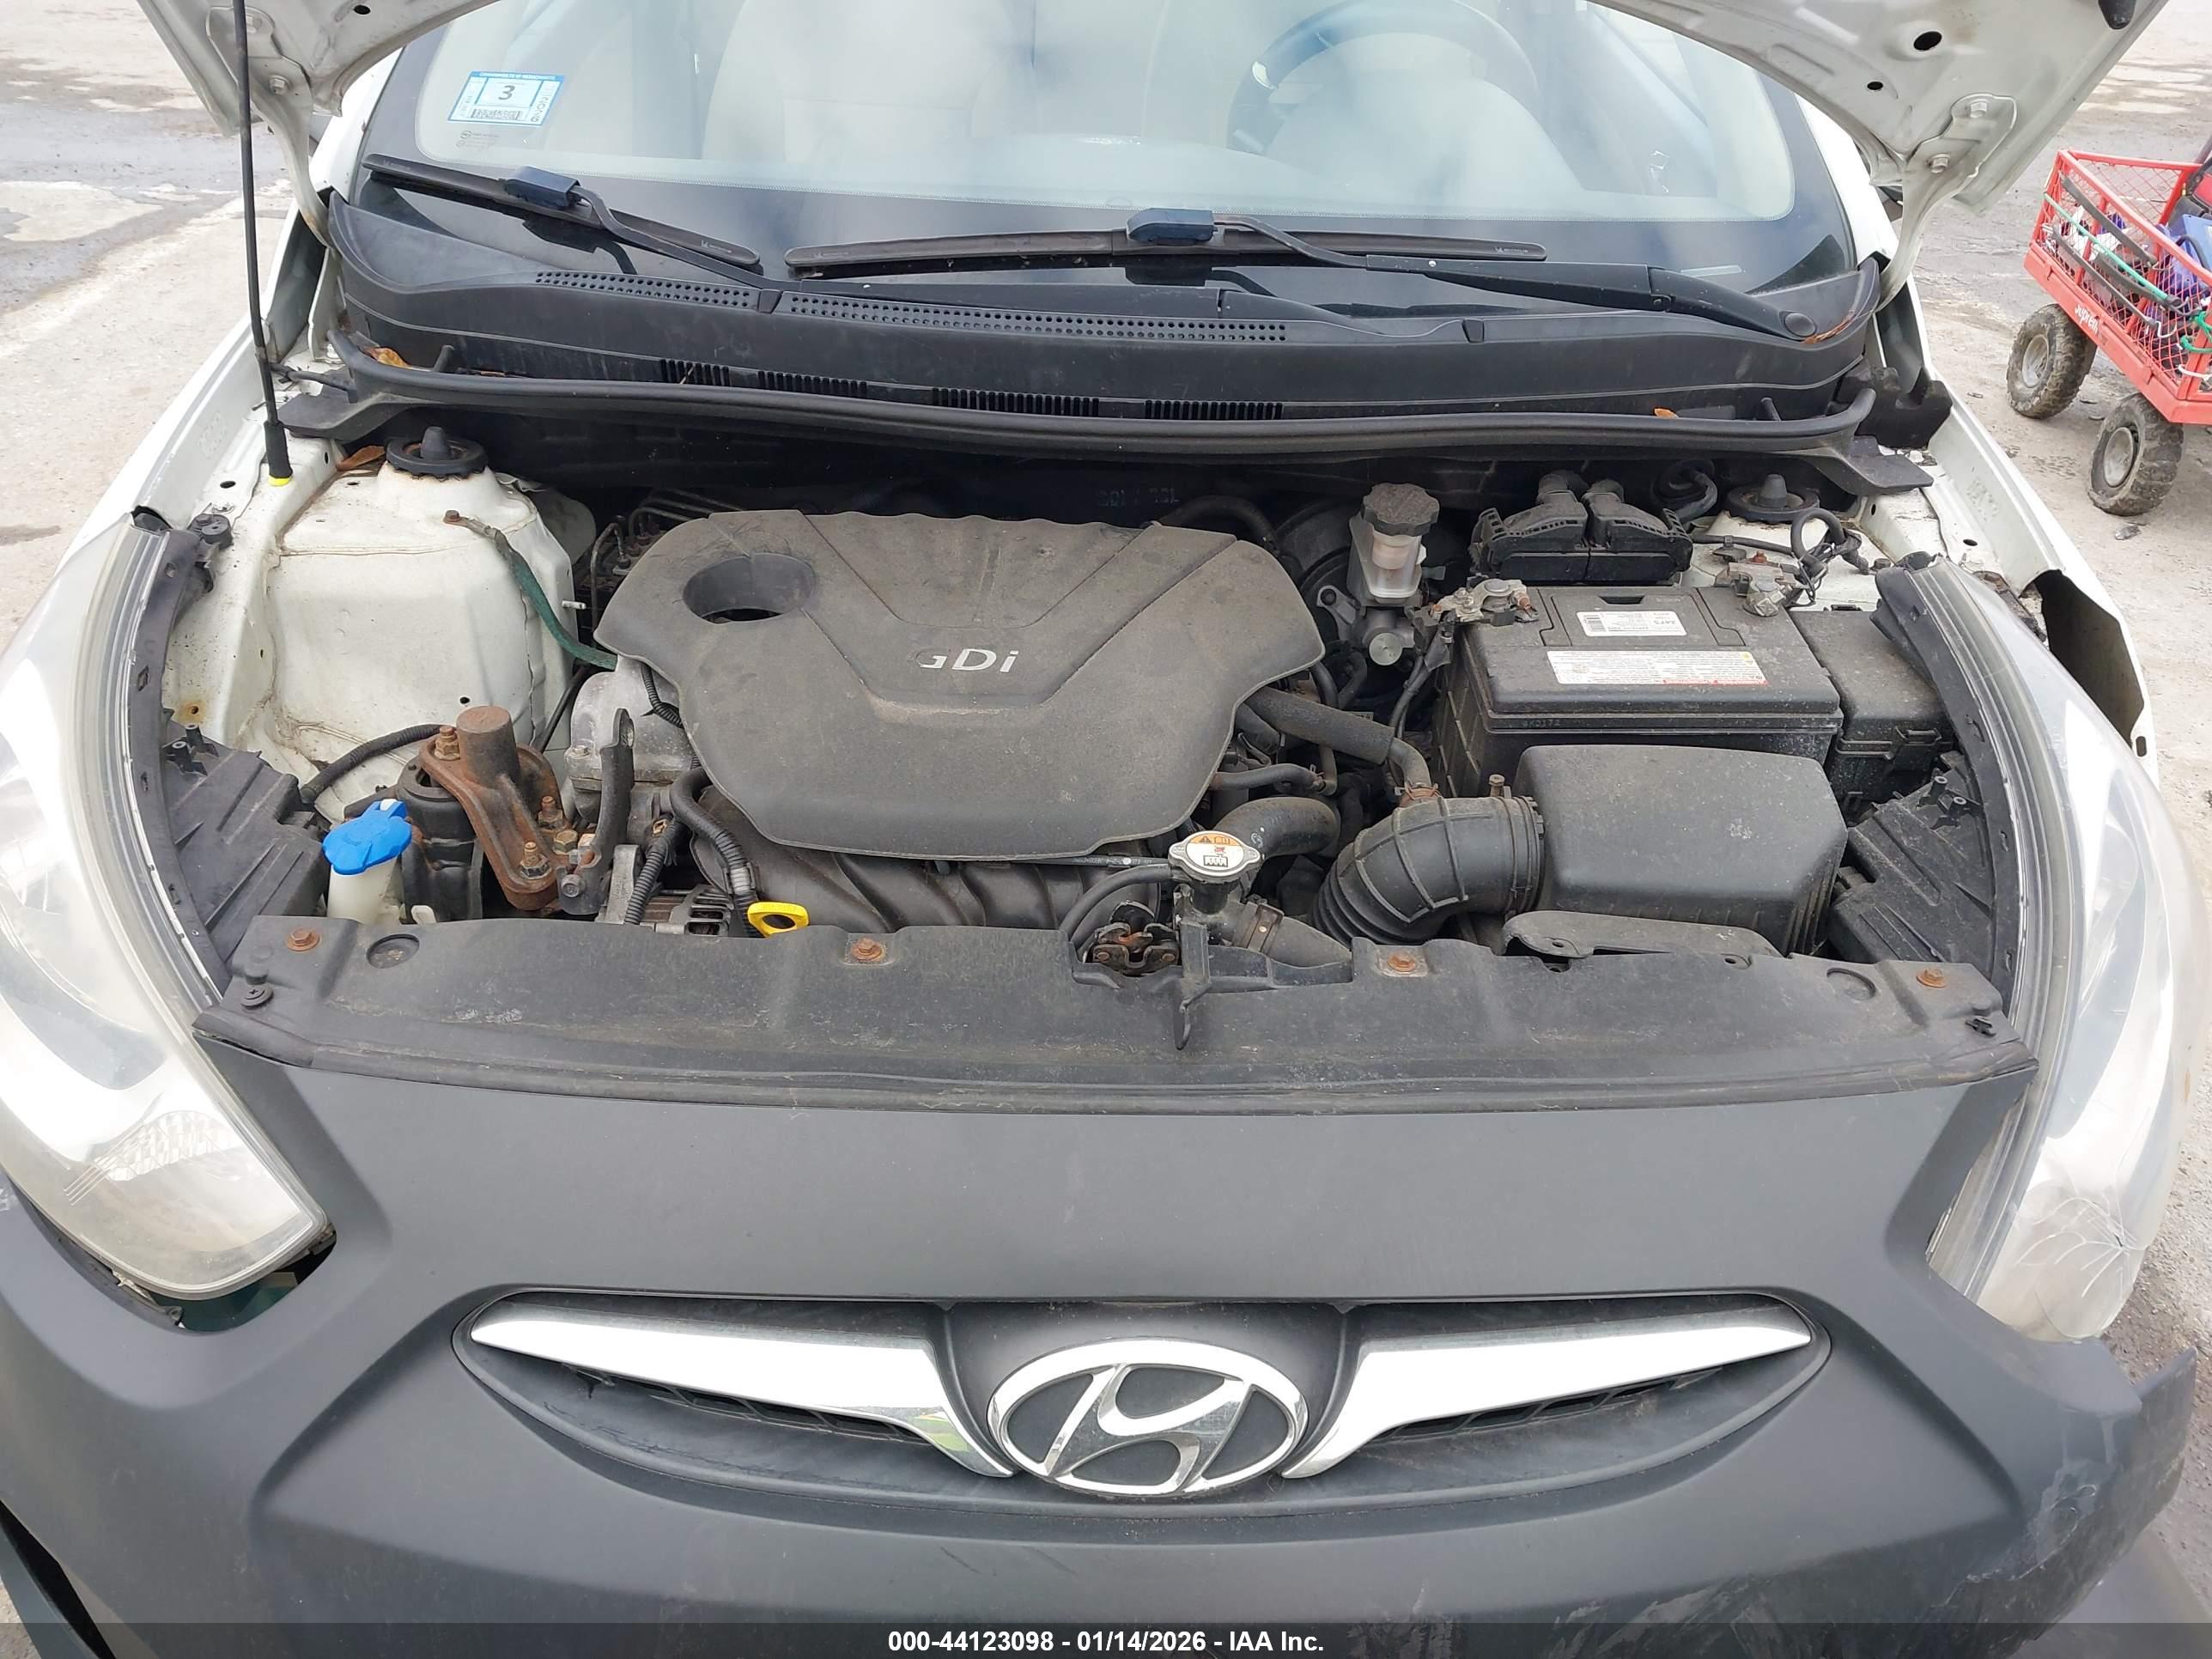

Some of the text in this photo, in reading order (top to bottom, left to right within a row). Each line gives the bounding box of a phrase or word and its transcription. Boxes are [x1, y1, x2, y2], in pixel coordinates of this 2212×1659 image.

[497, 84, 516, 101] 3
[530, 96, 550, 124] 2026
[909, 647, 1020, 673] GDi
